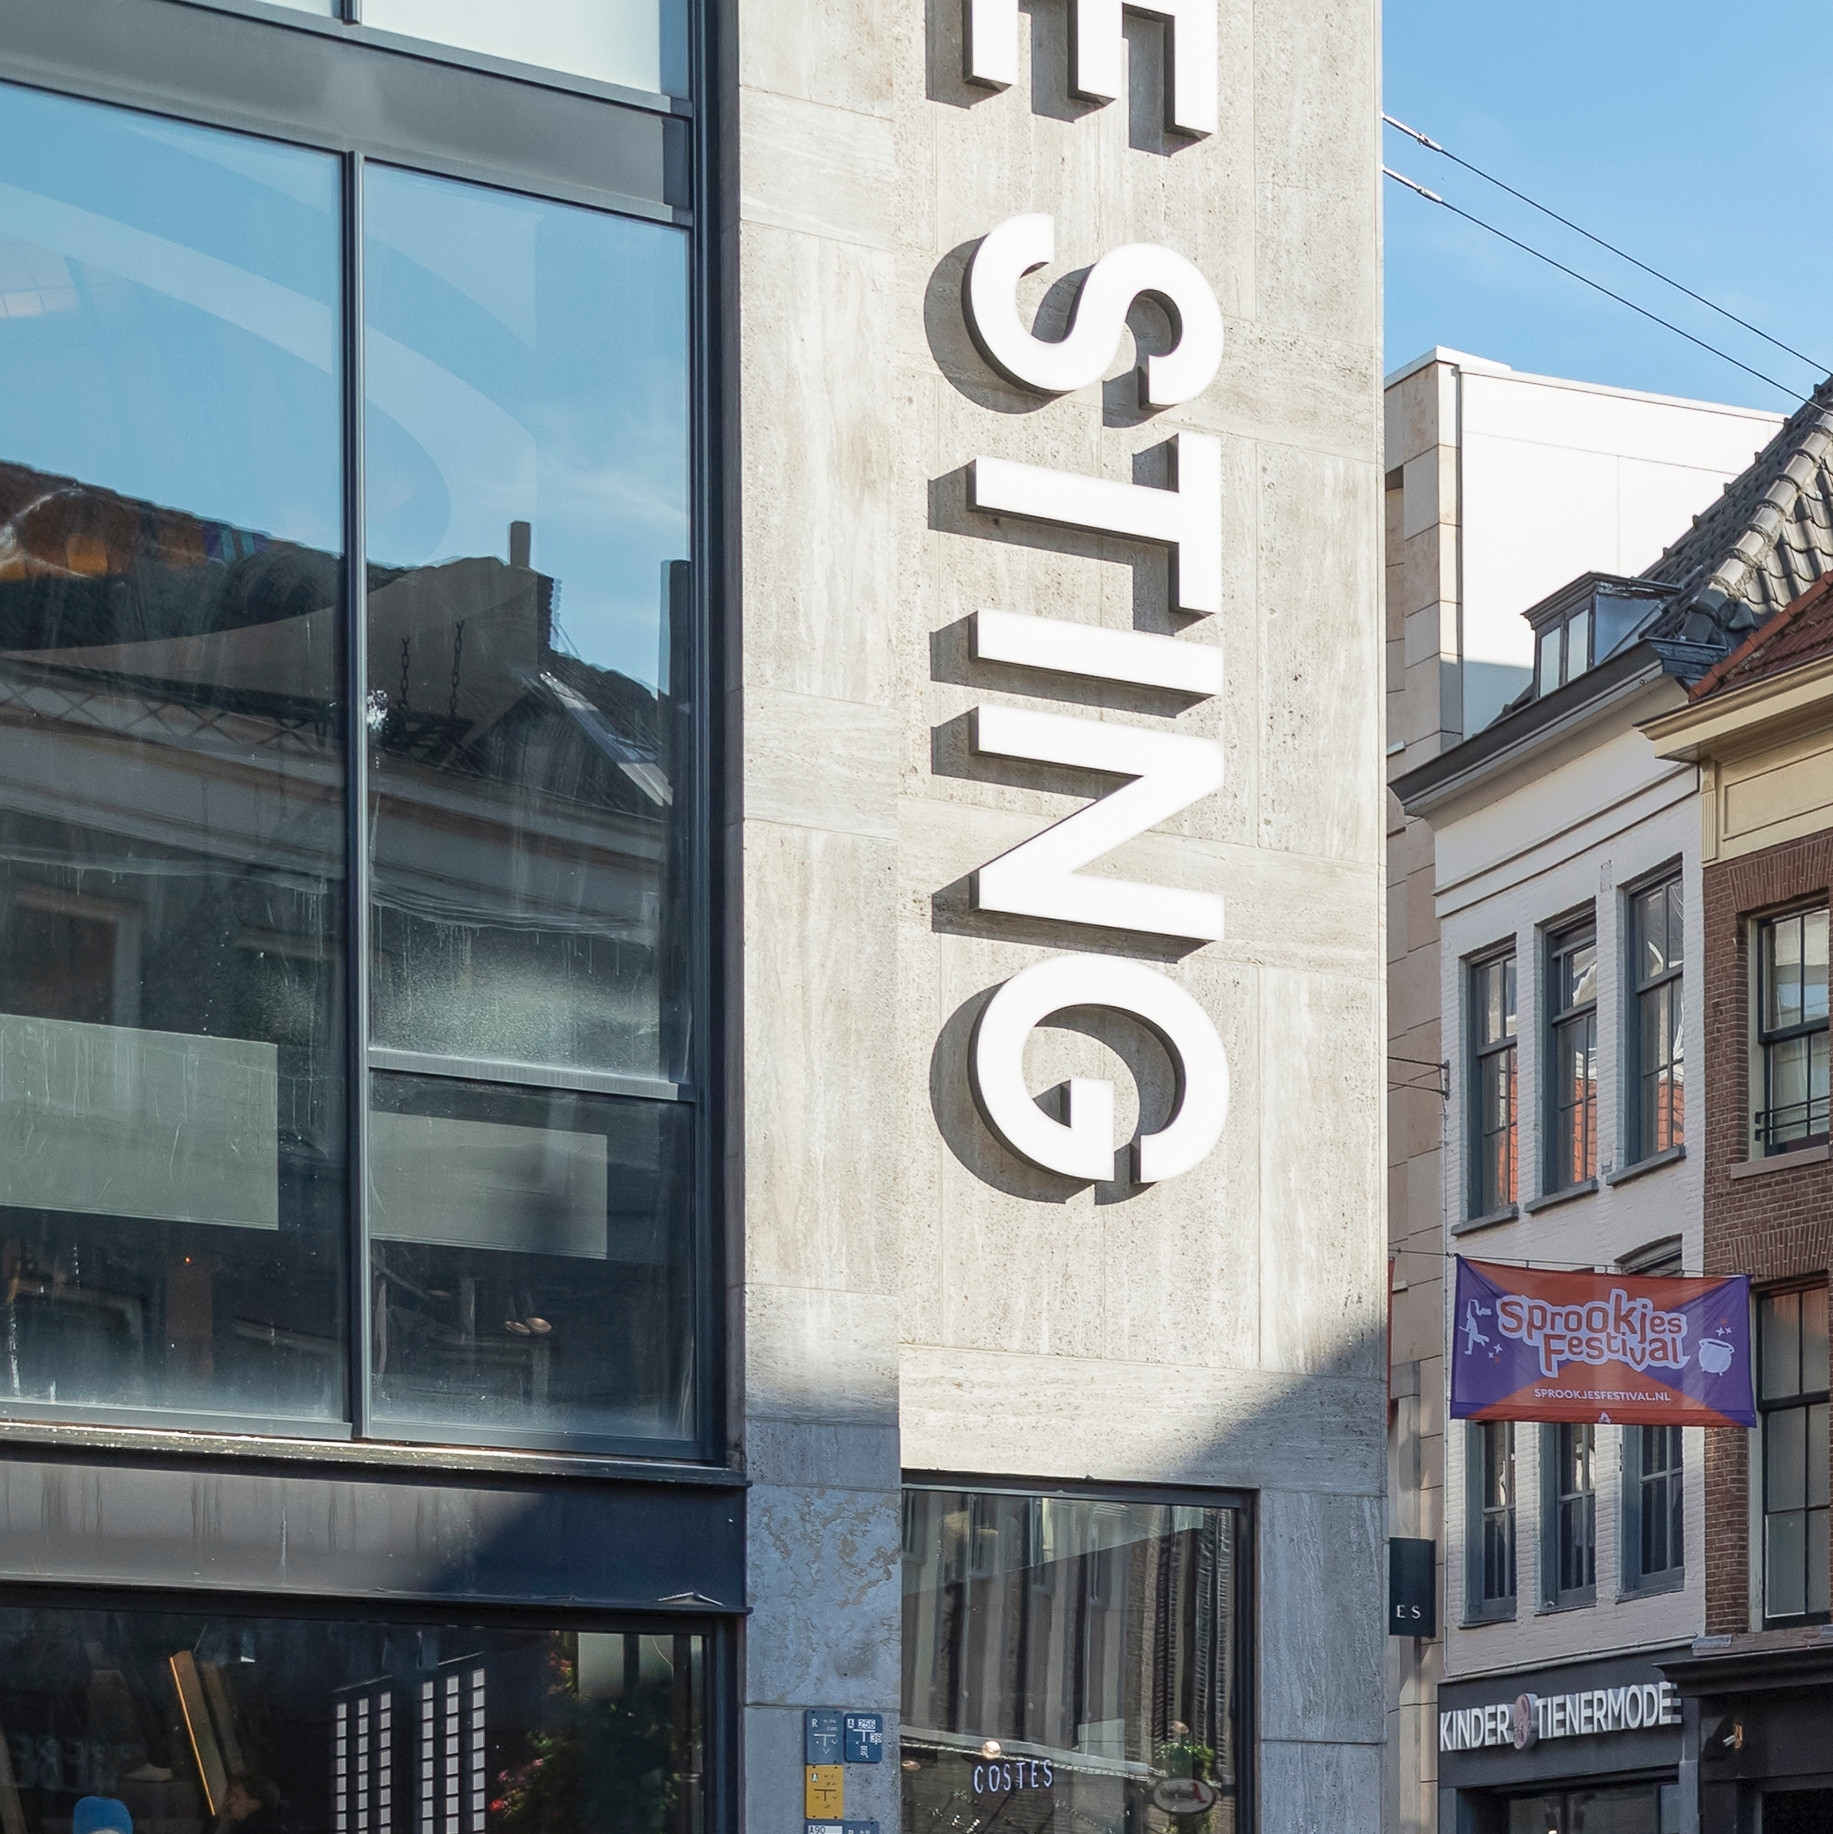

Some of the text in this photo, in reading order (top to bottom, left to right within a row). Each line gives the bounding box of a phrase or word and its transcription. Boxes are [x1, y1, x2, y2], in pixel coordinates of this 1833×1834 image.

[965, 213, 1229, 1184] STING
[1499, 1291, 1684, 1344] Sprookjes
[1542, 1330, 1682, 1374] Festival
[1534, 1388, 1672, 1402] SPROOKJESFESTIVAL.NL
[1440, 1681, 1681, 1752] KINDER TIENERMODE
[973, 1759, 1053, 1794] COSTES
